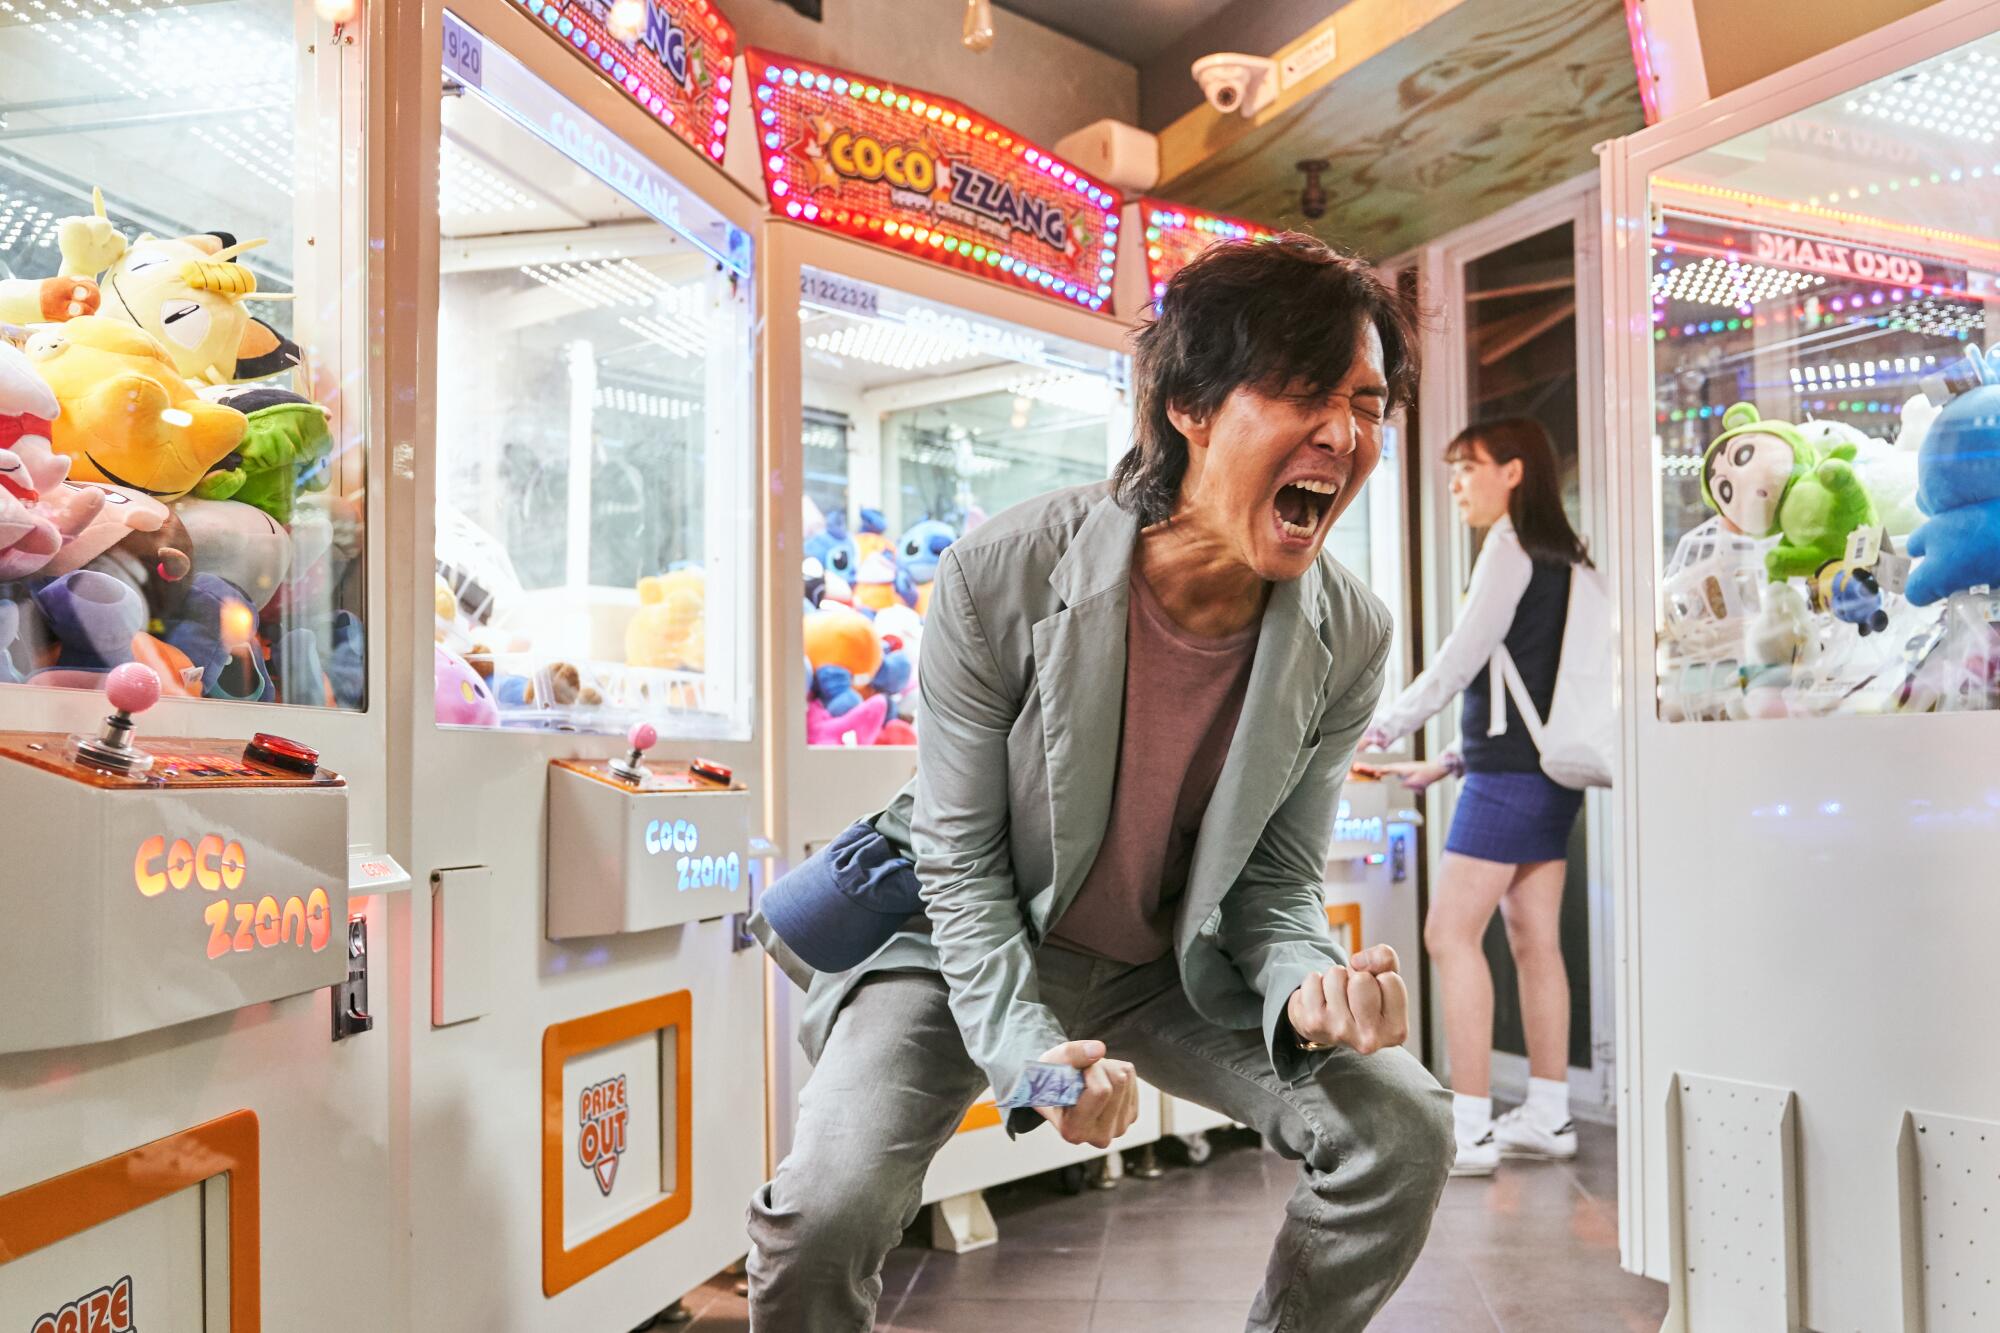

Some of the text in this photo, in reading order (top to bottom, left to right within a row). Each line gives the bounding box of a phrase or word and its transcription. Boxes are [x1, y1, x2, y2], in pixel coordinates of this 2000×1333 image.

[461, 40, 480, 75] 20
[551, 111, 609, 176] COCO
[829, 129, 1066, 248] COCO ZZANG
[800, 275, 815, 294] 21
[820, 281, 837, 301] 22
[645, 818, 698, 855] COCO
[134, 833, 247, 897] COCO
[580, 1078, 626, 1122] PRIZE
[580, 1108, 627, 1165] OUT
